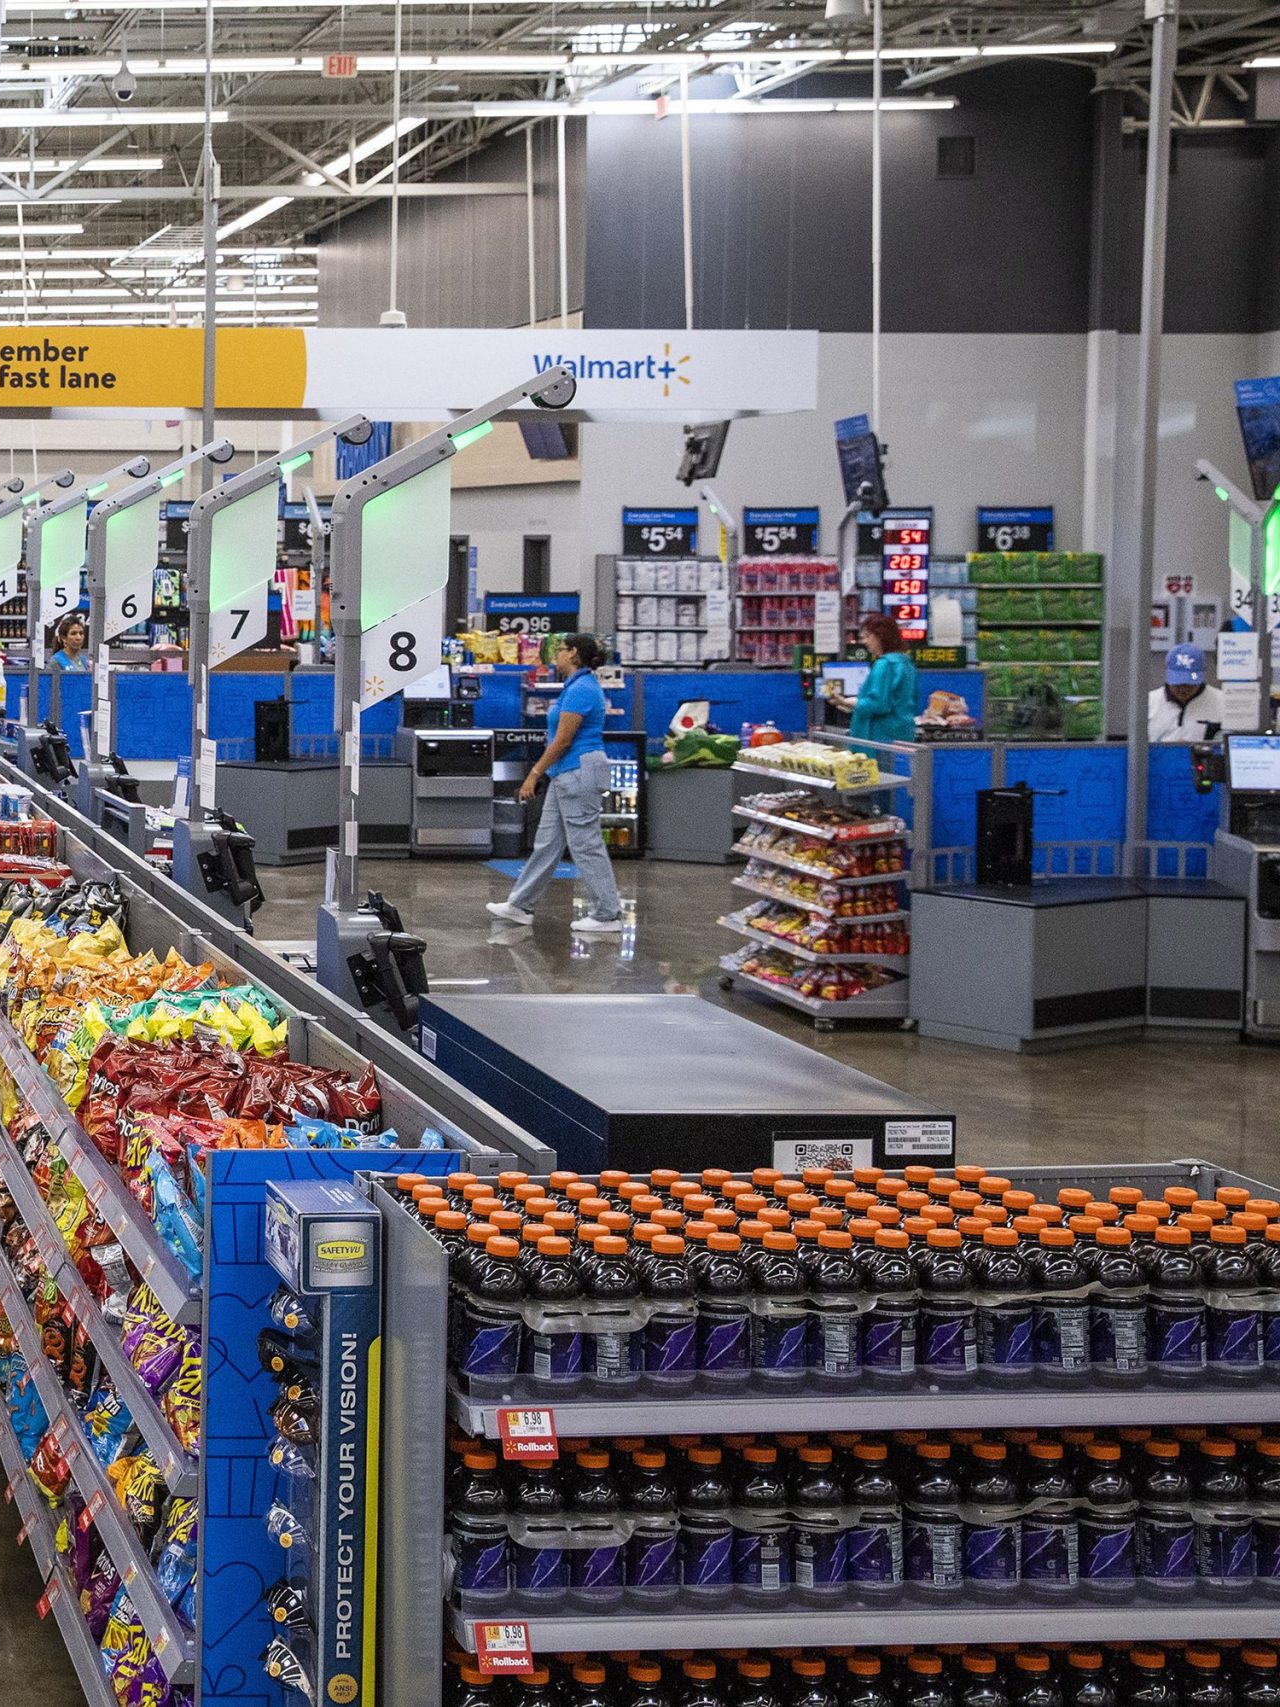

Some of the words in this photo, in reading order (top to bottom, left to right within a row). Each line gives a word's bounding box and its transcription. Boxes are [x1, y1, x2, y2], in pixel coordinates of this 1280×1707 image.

[328, 55, 354, 76] EXIT
[59, 365, 117, 388] lane
[900, 530, 921, 544] 54
[889, 555, 921, 569] 203
[894, 581, 921, 594] 150
[55, 587, 67, 607] 5
[1235, 589, 1252, 609] 34
[121, 594, 138, 618] 6
[899, 606, 920, 619] 27
[230, 610, 250, 639] 7
[388, 631, 418, 672] 8
[915, 650, 958, 662] HERE
[507, 733, 526, 743] Cart
[320, 1246, 361, 1255] SAFETYVU
[339, 1332, 357, 1429] VISION!
[523, 1412, 542, 1425] 6.98
[517, 1442, 554, 1452] Rollback
[337, 1433, 355, 1521] YOUR
[335, 1523, 354, 1659] PROTECT
[505, 1626, 523, 1639] 6.98
[493, 1656, 529, 1666] Rollback
